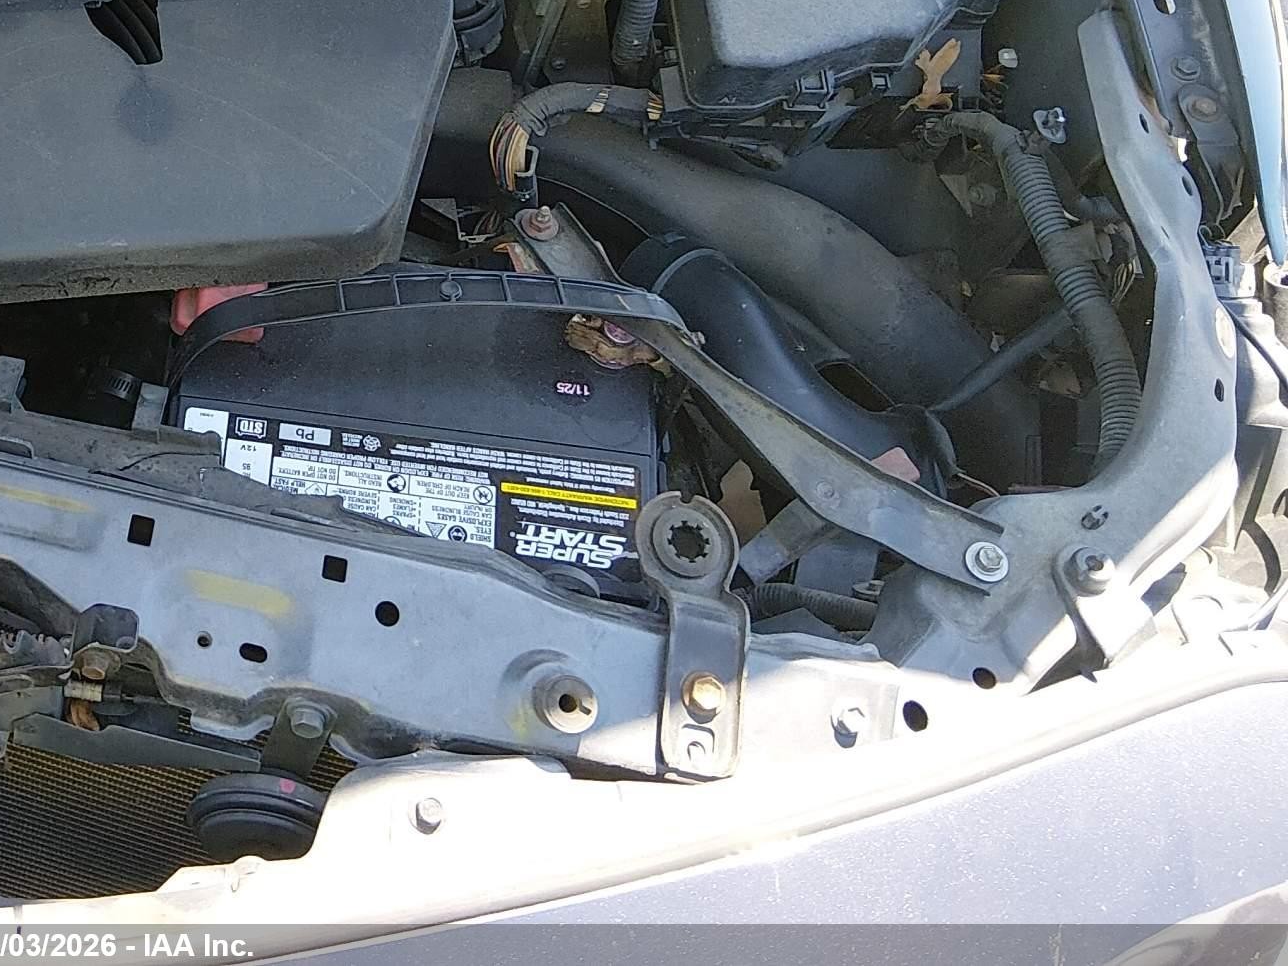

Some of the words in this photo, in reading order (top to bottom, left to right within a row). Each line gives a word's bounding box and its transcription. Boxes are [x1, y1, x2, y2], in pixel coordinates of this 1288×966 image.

[556, 382, 590, 396] 11/25
[238, 419, 262, 433] STD
[295, 428, 314, 440] Pb
[437, 513, 456, 521] GASES
[459, 516, 491, 525] EXPLOSIVE
[469, 533, 492, 543] SHIELD
[515, 524, 626, 555] START
[514, 540, 612, 568] SUPER
